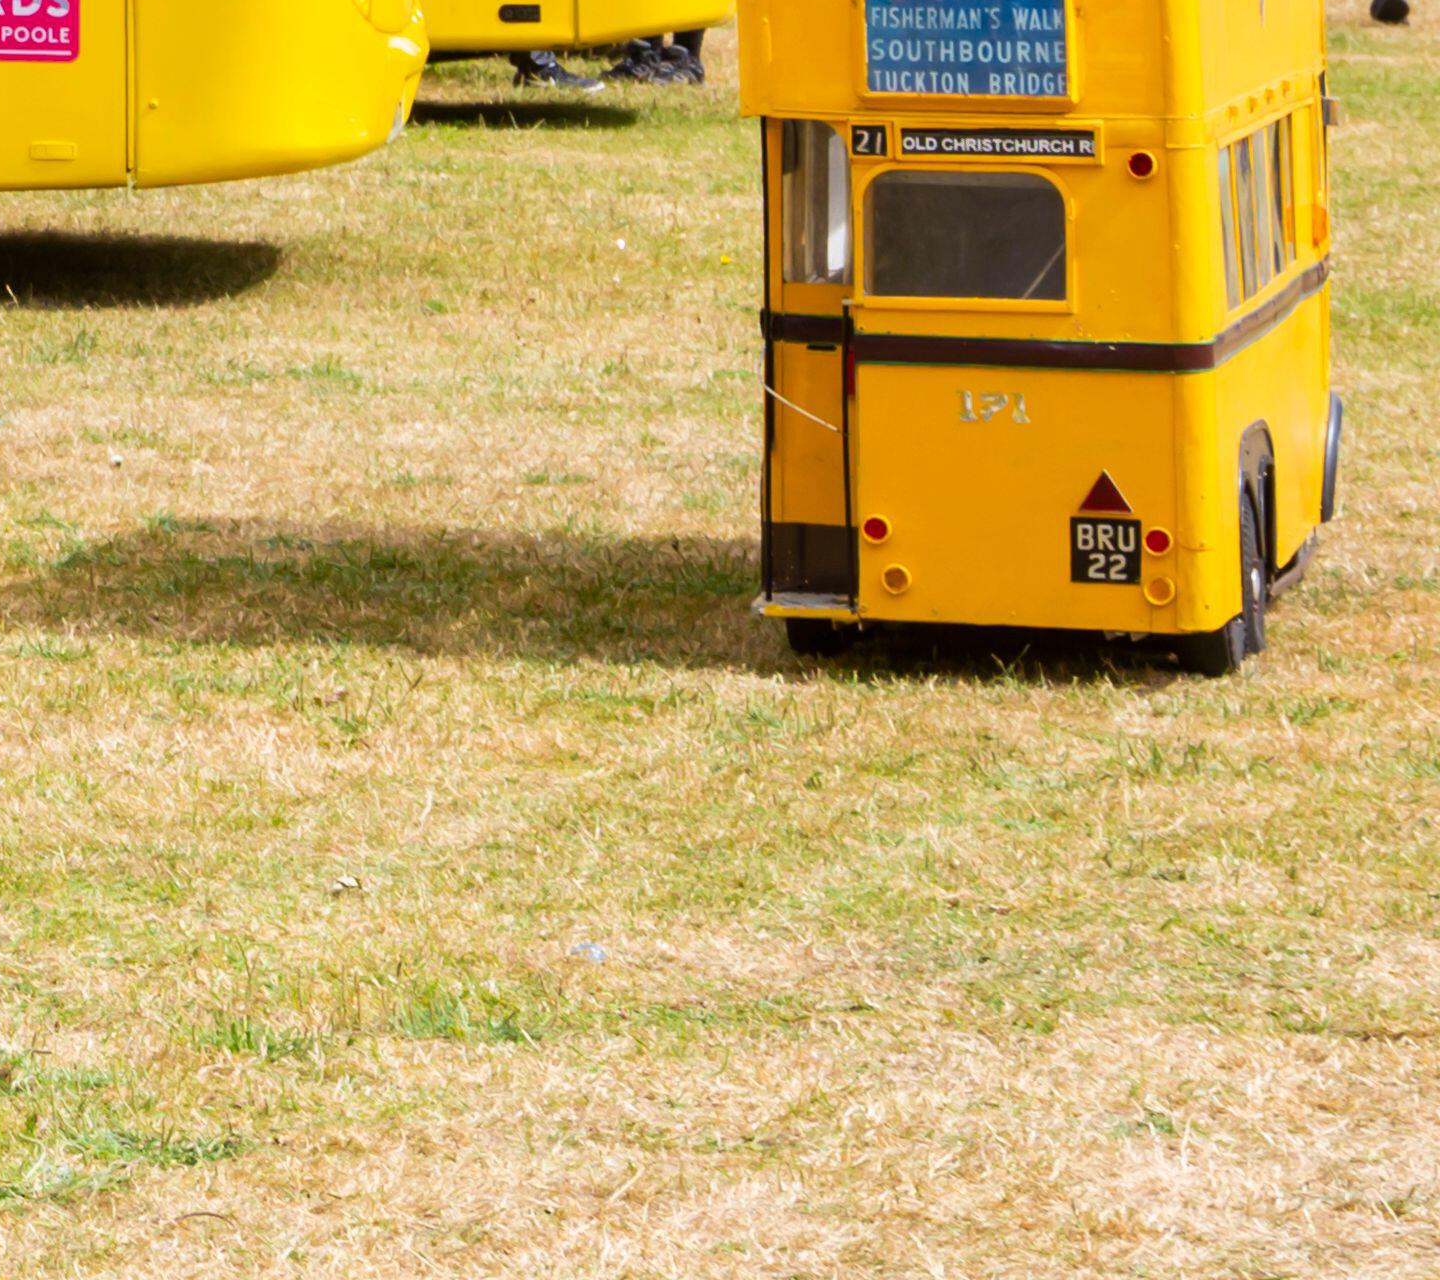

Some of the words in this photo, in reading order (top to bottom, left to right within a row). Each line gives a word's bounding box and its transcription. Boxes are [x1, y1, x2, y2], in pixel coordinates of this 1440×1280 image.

[871, 6, 1002, 31] FISHERMAN'S
[1011, 7, 1063, 32] WALK
[0, 26, 71, 45] POOLE
[871, 38, 1066, 65] SOUTHBOURNE
[874, 69, 970, 95] TUCKTON
[856, 130, 882, 155] 21
[902, 136, 938, 152] OLD
[941, 136, 1075, 155] CHRISTCHURCH
[1079, 138, 1095, 155] R
[1076, 523, 1137, 553] BRU
[1088, 553, 1129, 581] 22
